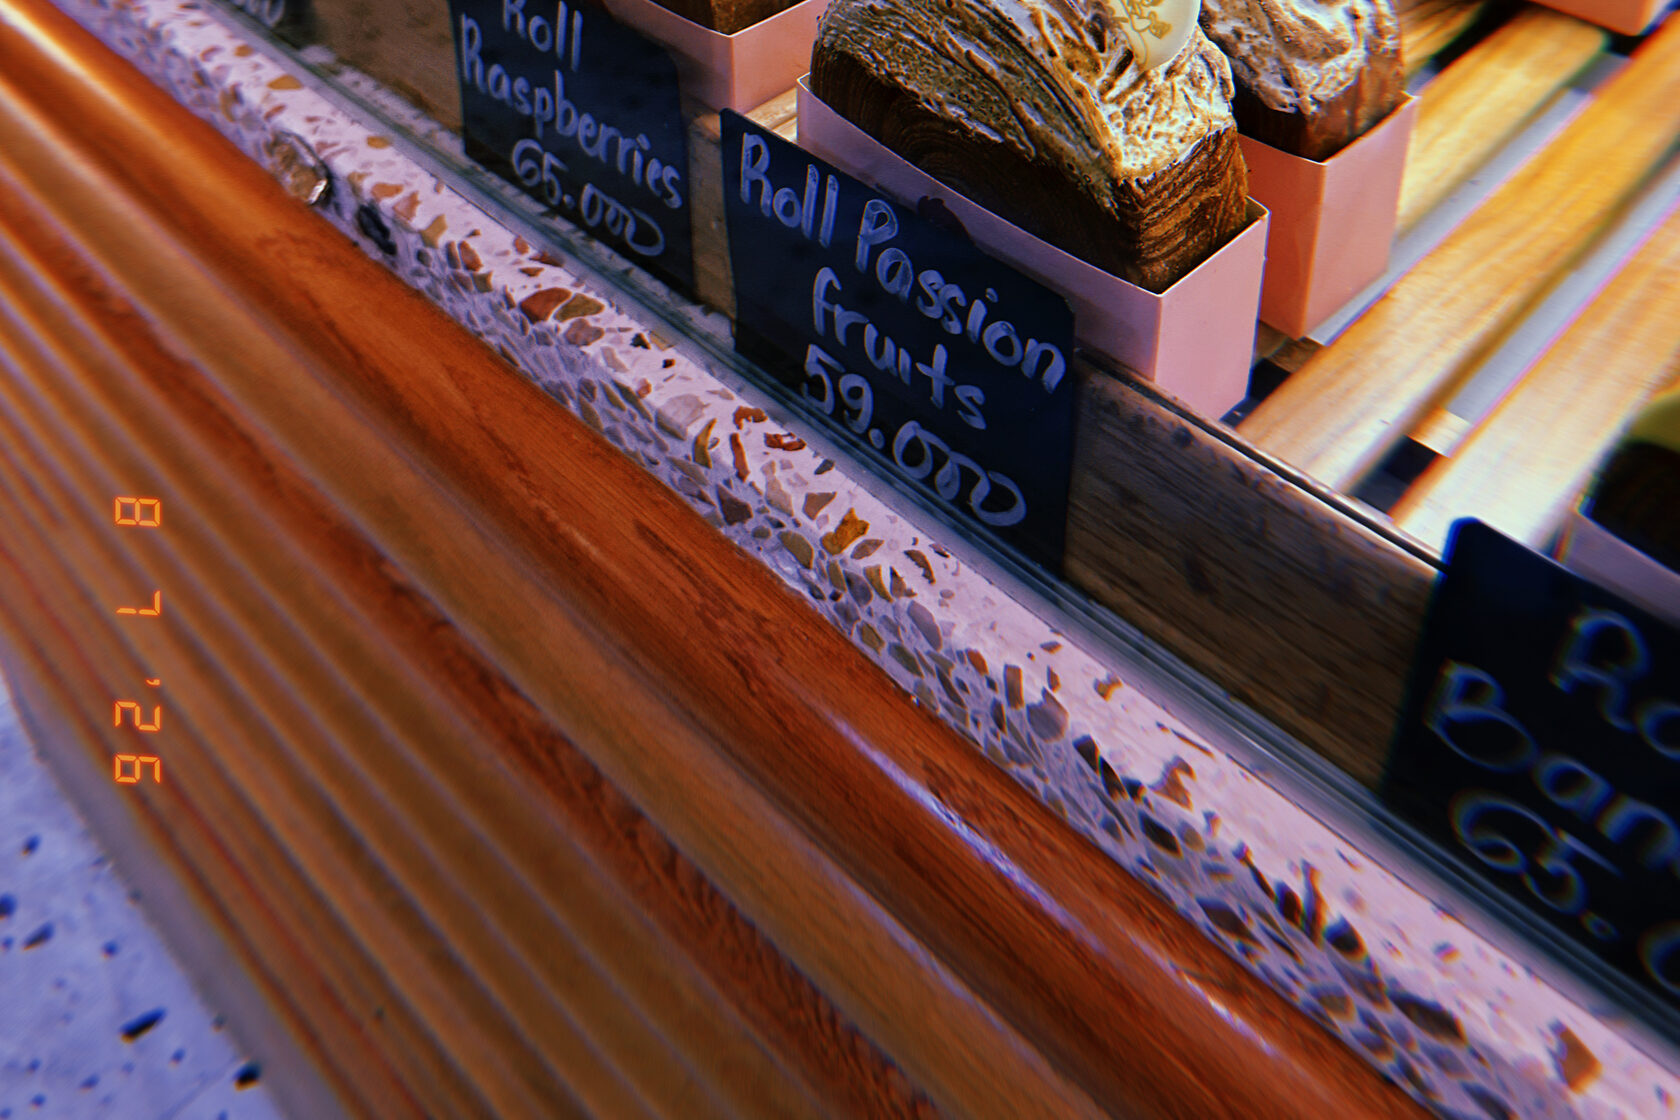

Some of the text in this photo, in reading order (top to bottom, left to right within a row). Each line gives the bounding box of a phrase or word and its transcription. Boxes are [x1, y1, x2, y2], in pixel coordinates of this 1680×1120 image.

[461, 13, 683, 209] Raspberries
[512, 138, 665, 257] 65.000
[740, 132, 1067, 394] Roll Passion
[802, 344, 1027, 527] 59.000
